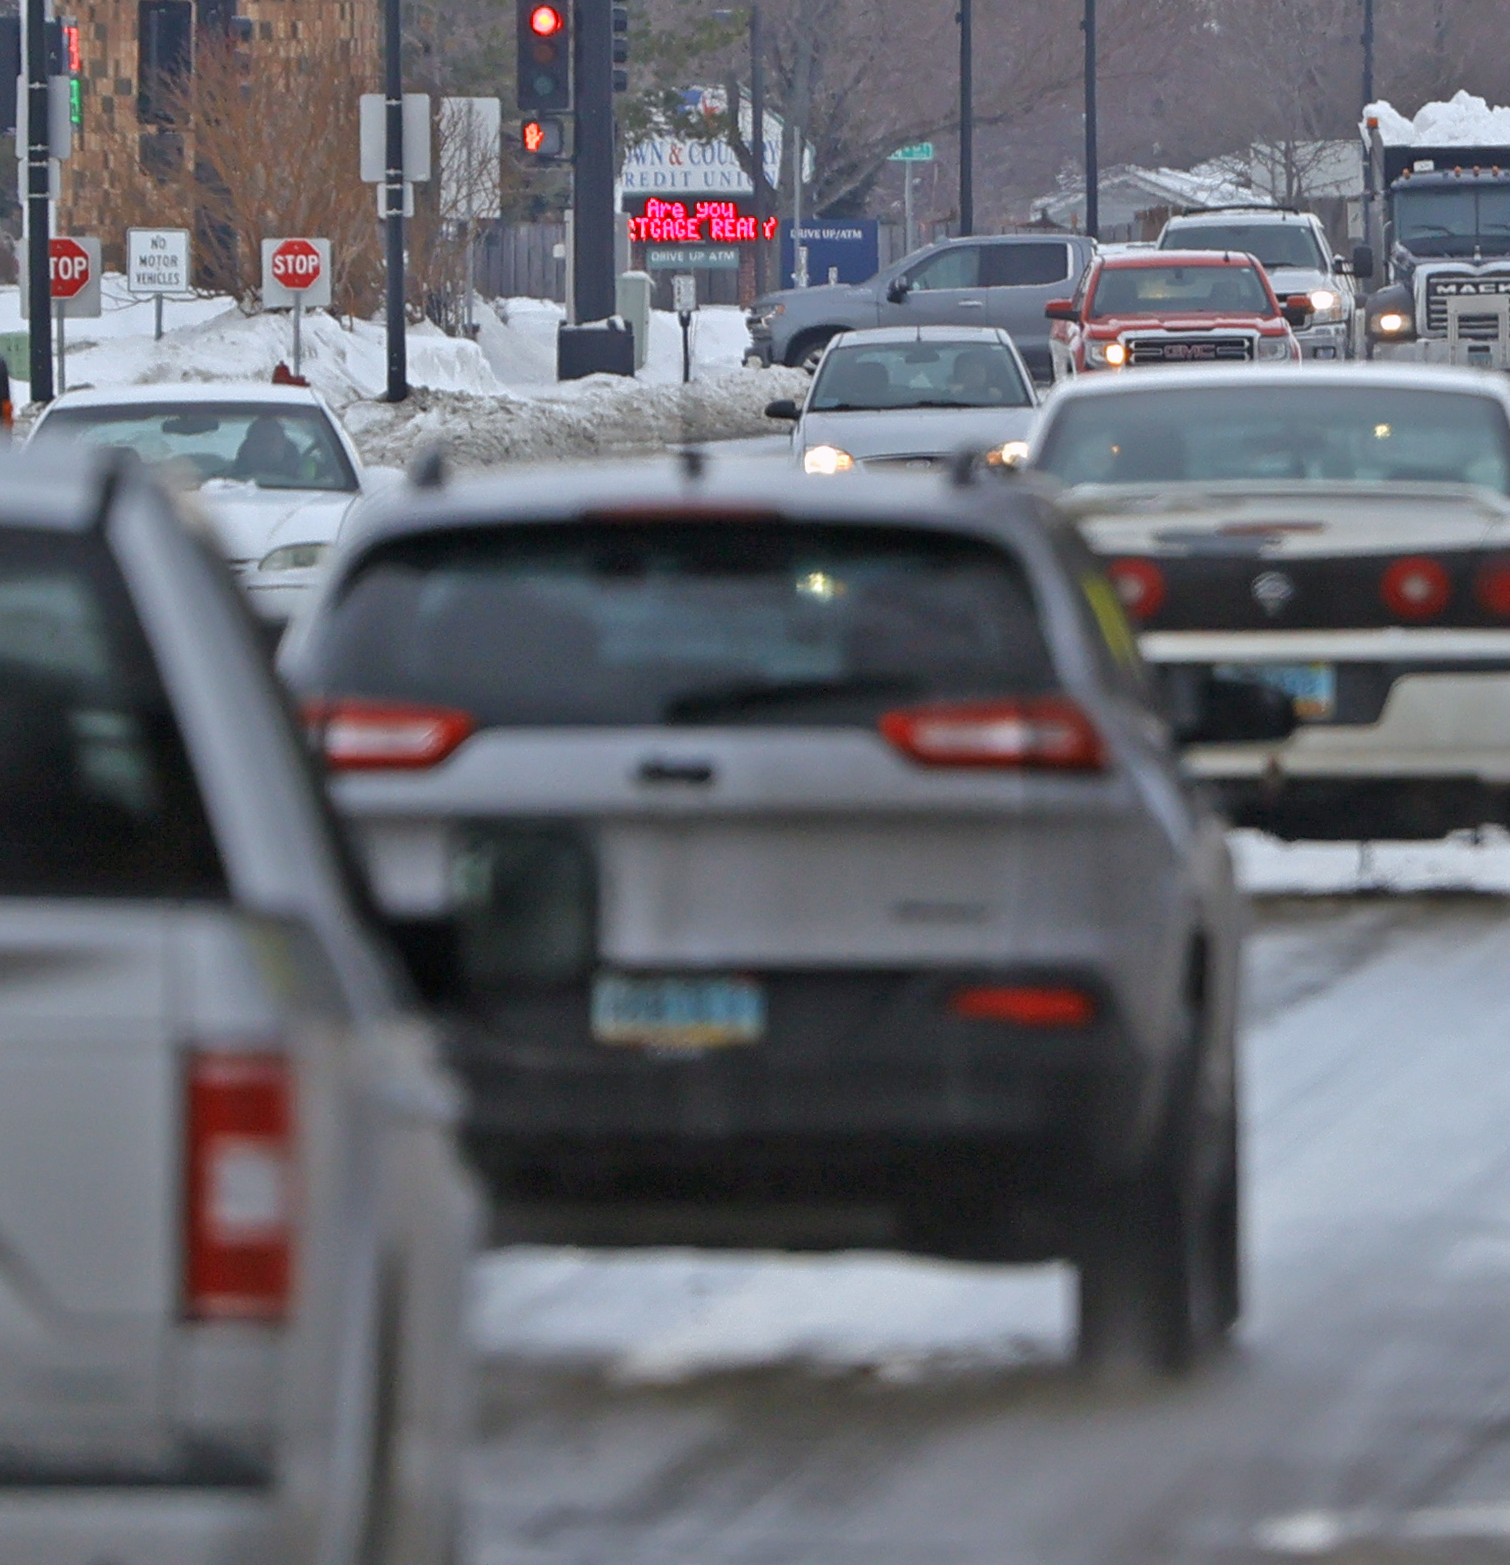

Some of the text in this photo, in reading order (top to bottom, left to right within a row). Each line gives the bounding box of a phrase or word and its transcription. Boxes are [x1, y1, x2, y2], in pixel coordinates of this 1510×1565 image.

[668, 142, 683, 166] &
[624, 170, 692, 187] REDIT
[646, 198, 734, 218] Are you
[150, 237, 167, 250] NO
[139, 255, 179, 268] MOTOR
[272, 254, 320, 275] STOP
[650, 250, 735, 263] DRIVE UP ATM
[49, 255, 88, 280] TOP
[135, 272, 180, 286] VEHICLES
[1163, 344, 1216, 359] GMC
